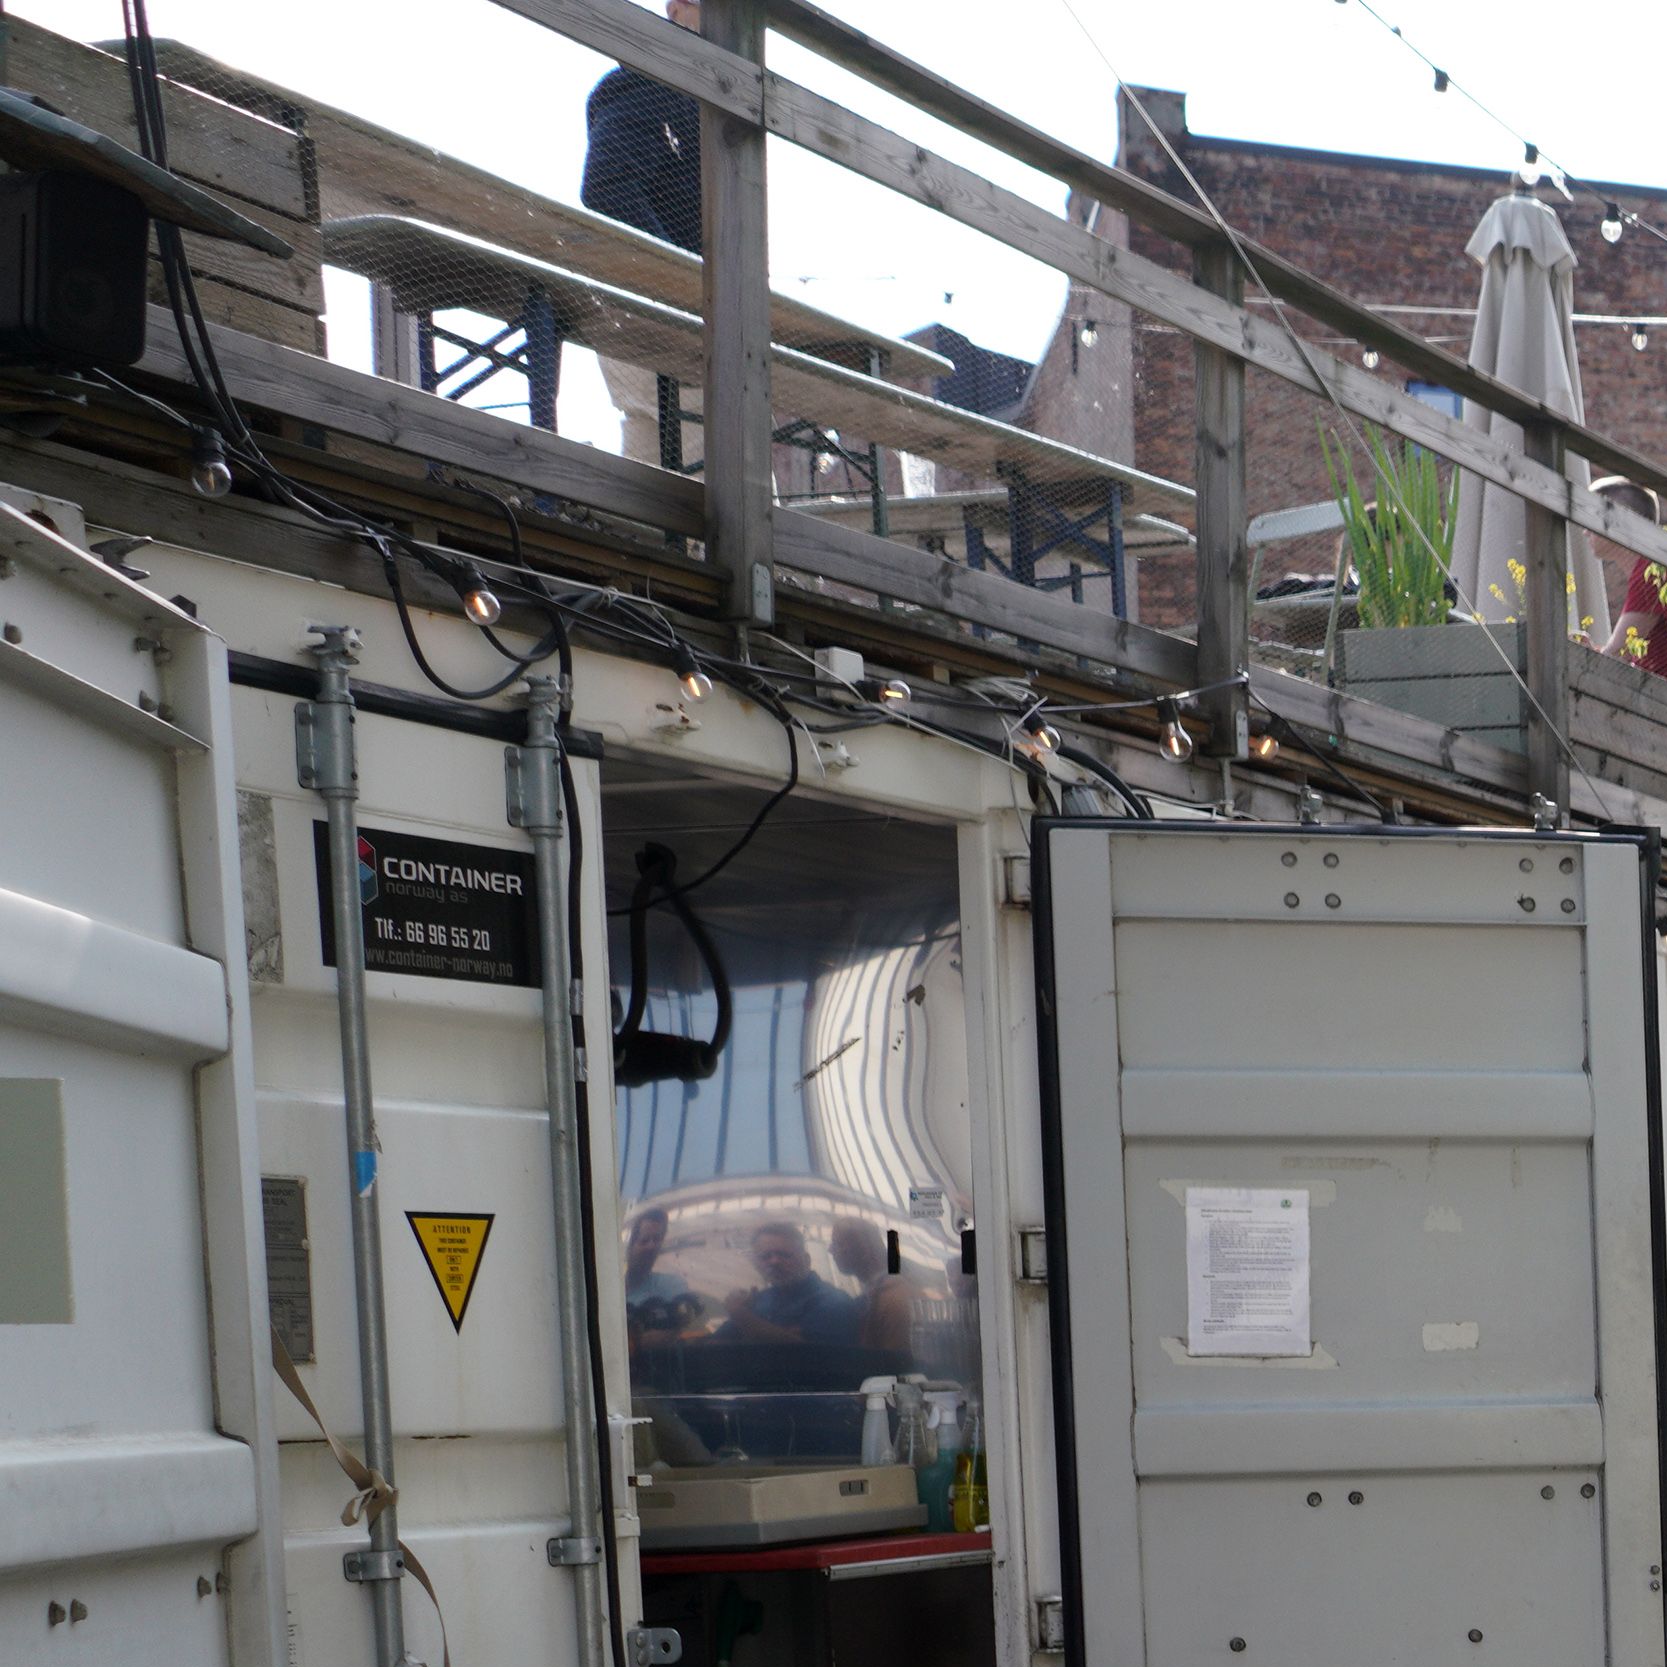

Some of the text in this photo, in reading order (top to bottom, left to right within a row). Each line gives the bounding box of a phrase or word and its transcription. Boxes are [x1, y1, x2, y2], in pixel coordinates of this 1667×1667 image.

[383, 857, 523, 896] CONTAINER
[385, 881, 469, 904] norway as
[375, 917, 491, 951] Tlf.: 66 96 55 20
[433, 1225, 471, 1234] ATTENTION
